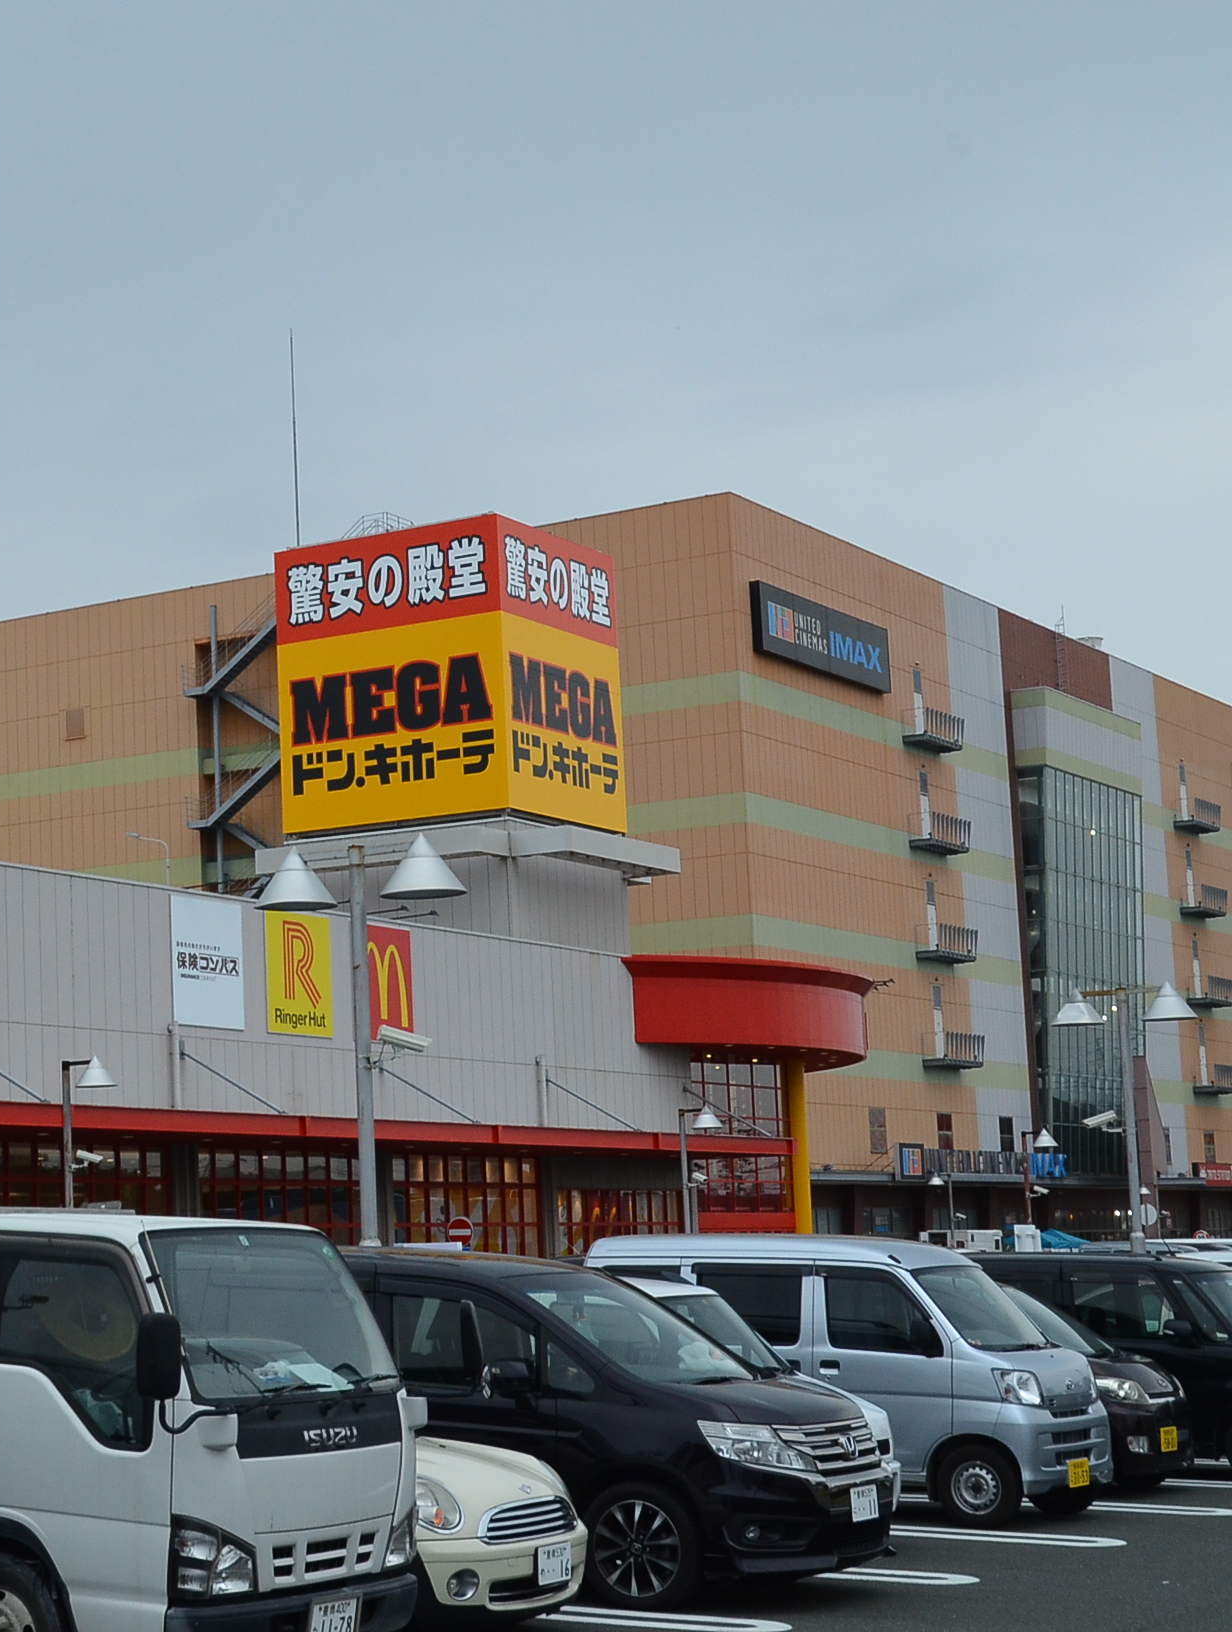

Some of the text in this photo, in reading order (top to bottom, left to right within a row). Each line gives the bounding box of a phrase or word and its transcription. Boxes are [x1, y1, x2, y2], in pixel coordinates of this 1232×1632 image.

[287, 535, 486, 626] 驚安の殿堂
[504, 534, 612, 628] 驚安の殿堂
[794, 611, 821, 635] UNITED
[795, 629, 828, 655] CINEMAS
[829, 631, 883, 674] IMAX
[289, 652, 494, 747] MEGA
[508, 650, 618, 748] MEGA
[177, 951, 239, 975] 保険コンパス
[282, 920, 322, 1009] R
[275, 1008, 326, 1029] Ringer Hut
[303, 1426, 358, 1446] ISUZU
